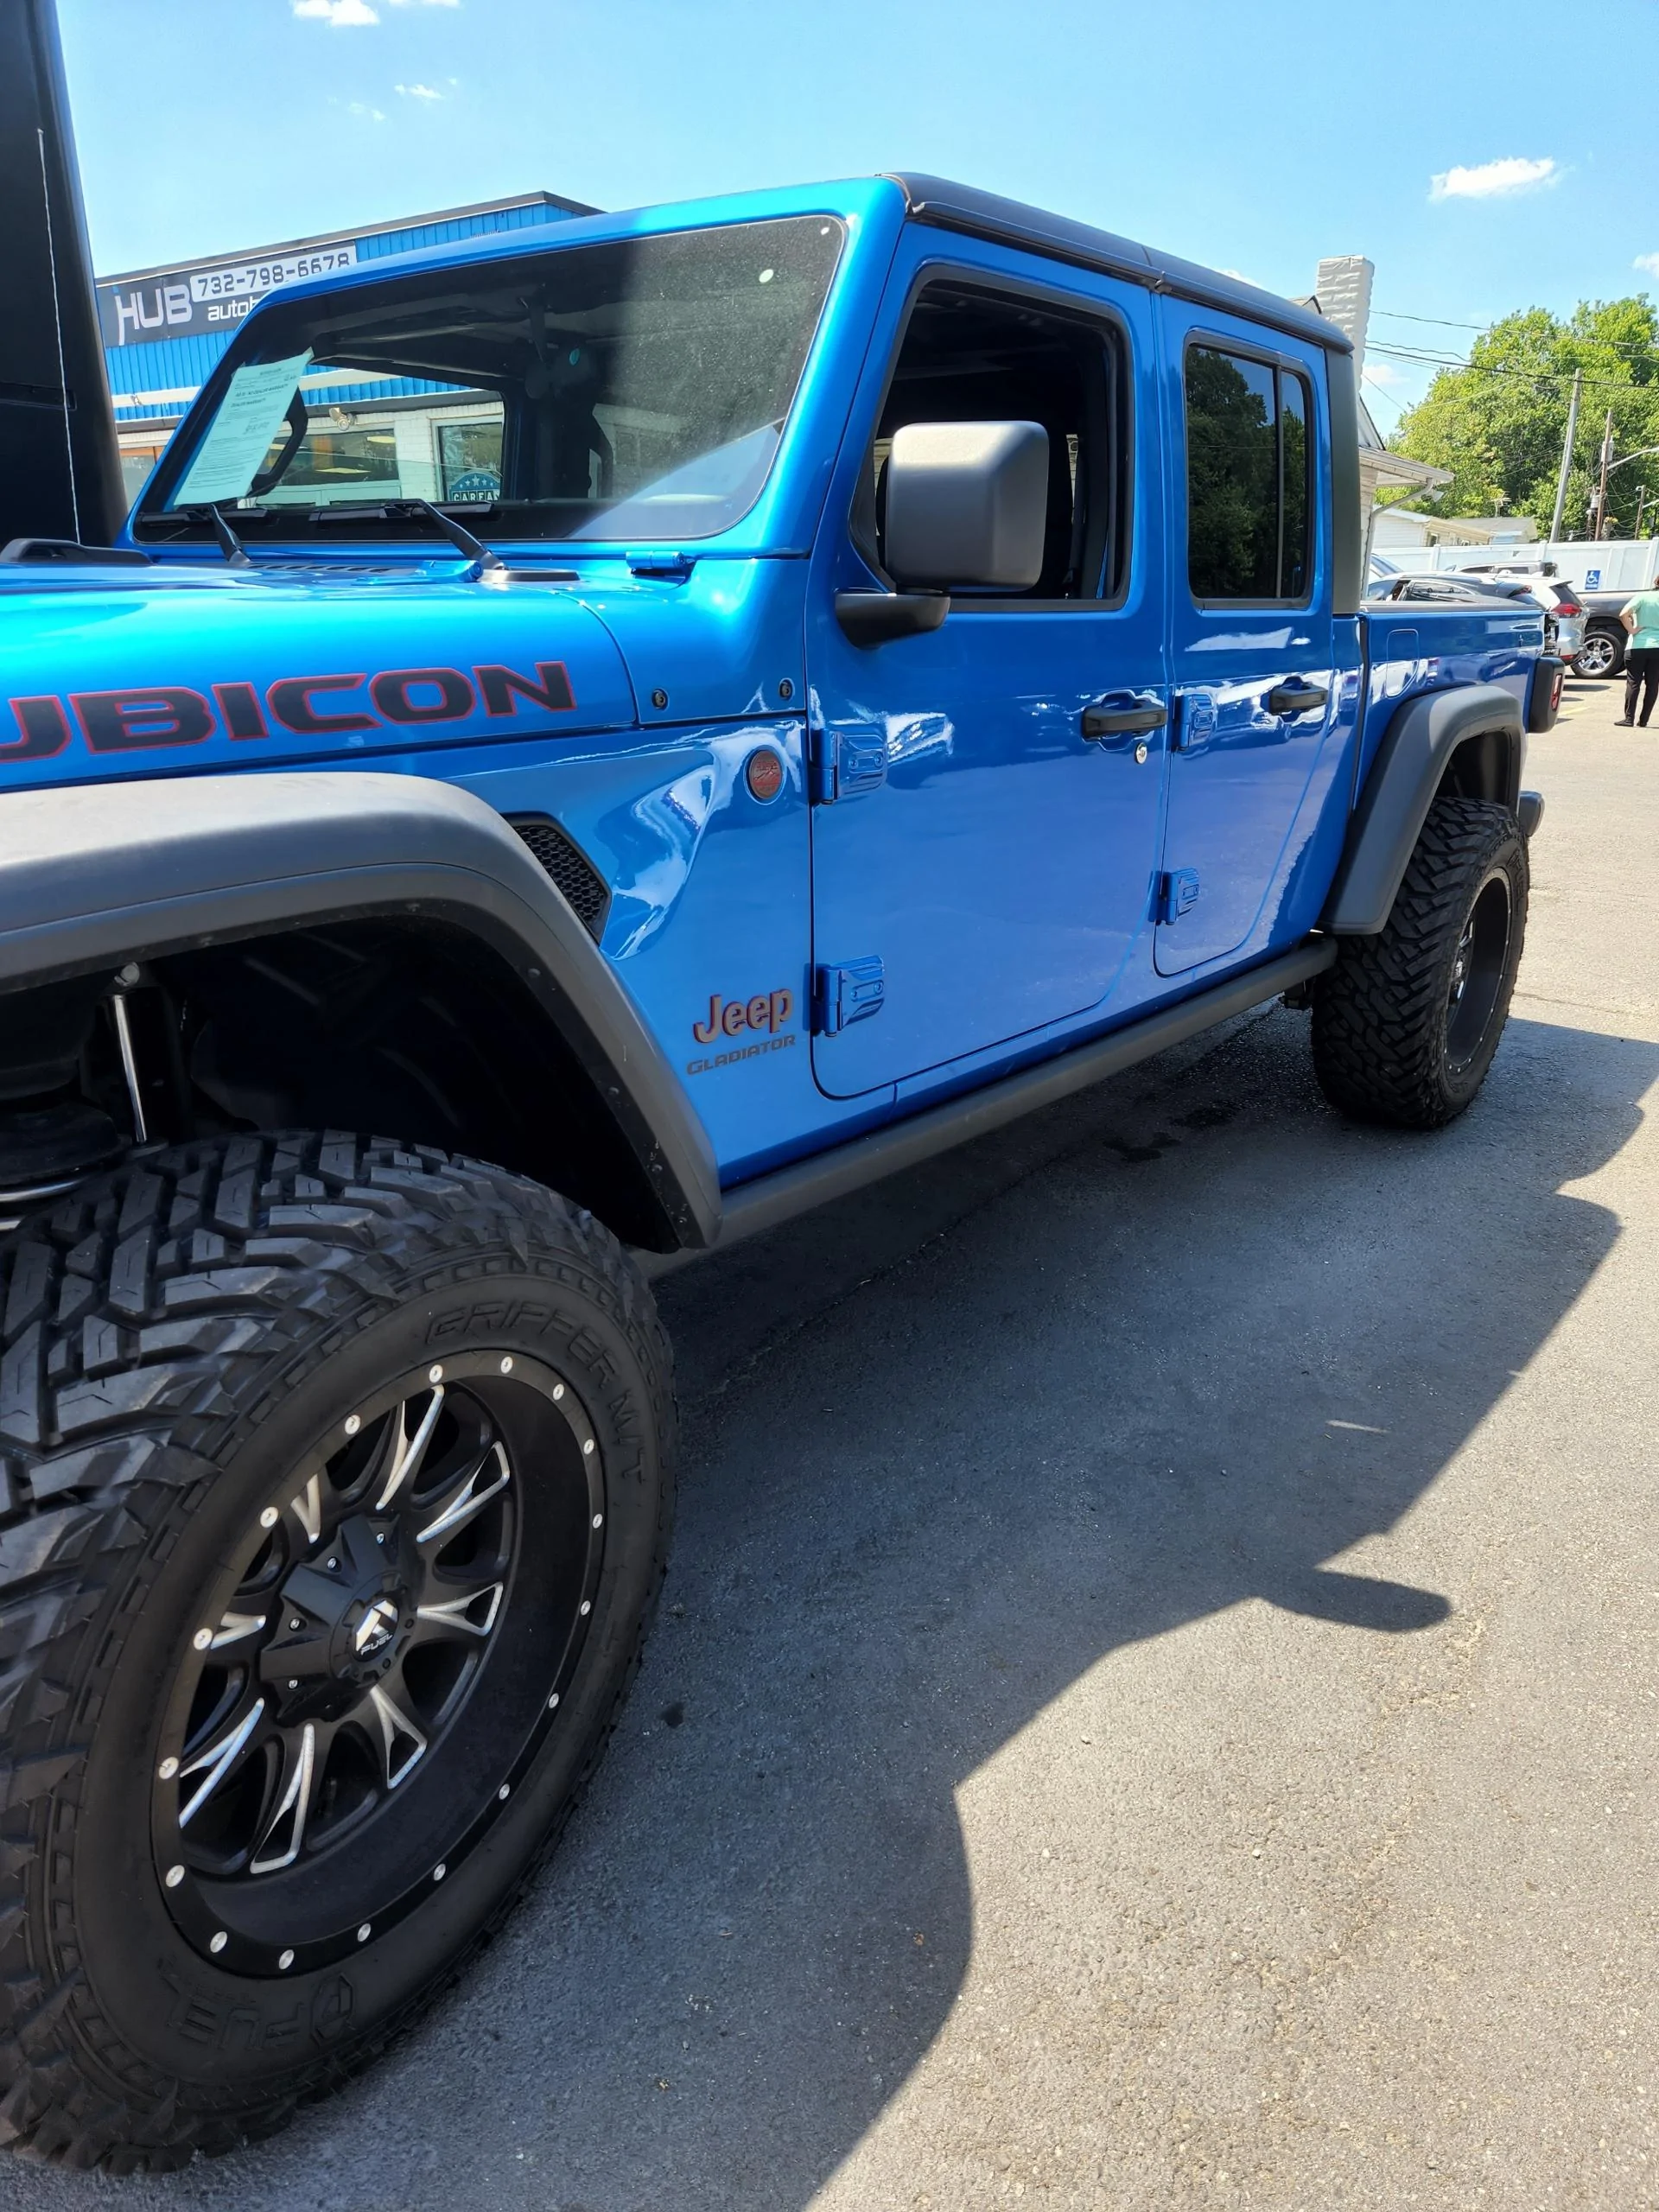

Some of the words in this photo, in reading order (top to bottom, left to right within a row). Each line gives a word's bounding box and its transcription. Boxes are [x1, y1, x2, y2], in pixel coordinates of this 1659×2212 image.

[197, 251, 350, 297] 732-798-6678
[207, 296, 261, 322] autob
[0, 661, 578, 763] UBICON
[693, 988, 793, 1044] Jeep
[687, 1034, 796, 1076] GLADIATOR
[360, 1633, 394, 1656] FUEL
